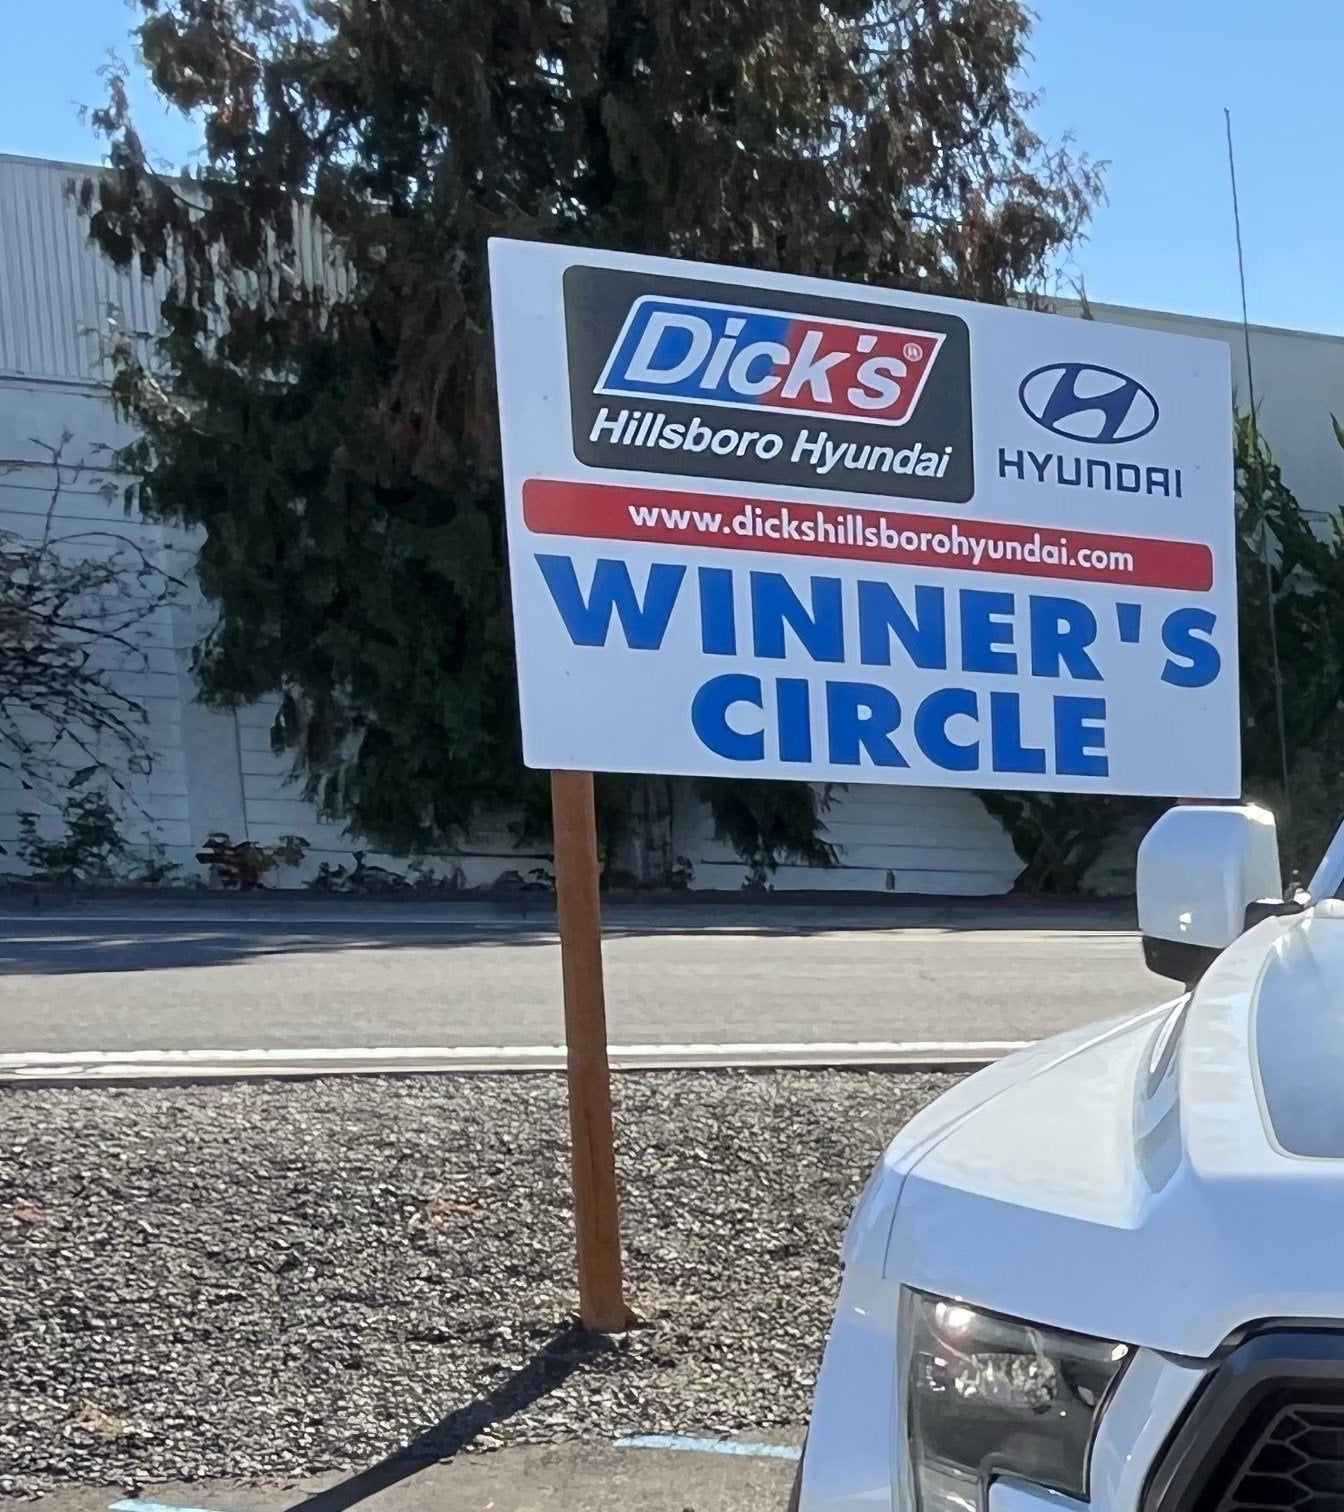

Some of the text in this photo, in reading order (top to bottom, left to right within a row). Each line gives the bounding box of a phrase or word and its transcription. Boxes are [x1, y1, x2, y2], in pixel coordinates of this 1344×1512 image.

[624, 312, 908, 410] Dick's
[588, 408, 953, 479] Hillsboro Hyundai
[998, 448, 1184, 498] HYUNDAI
[628, 502, 1135, 574] www.dickshillsborohyundai.com
[534, 553, 1222, 689] WINNER'S
[690, 673, 1110, 778] CIRCLE
